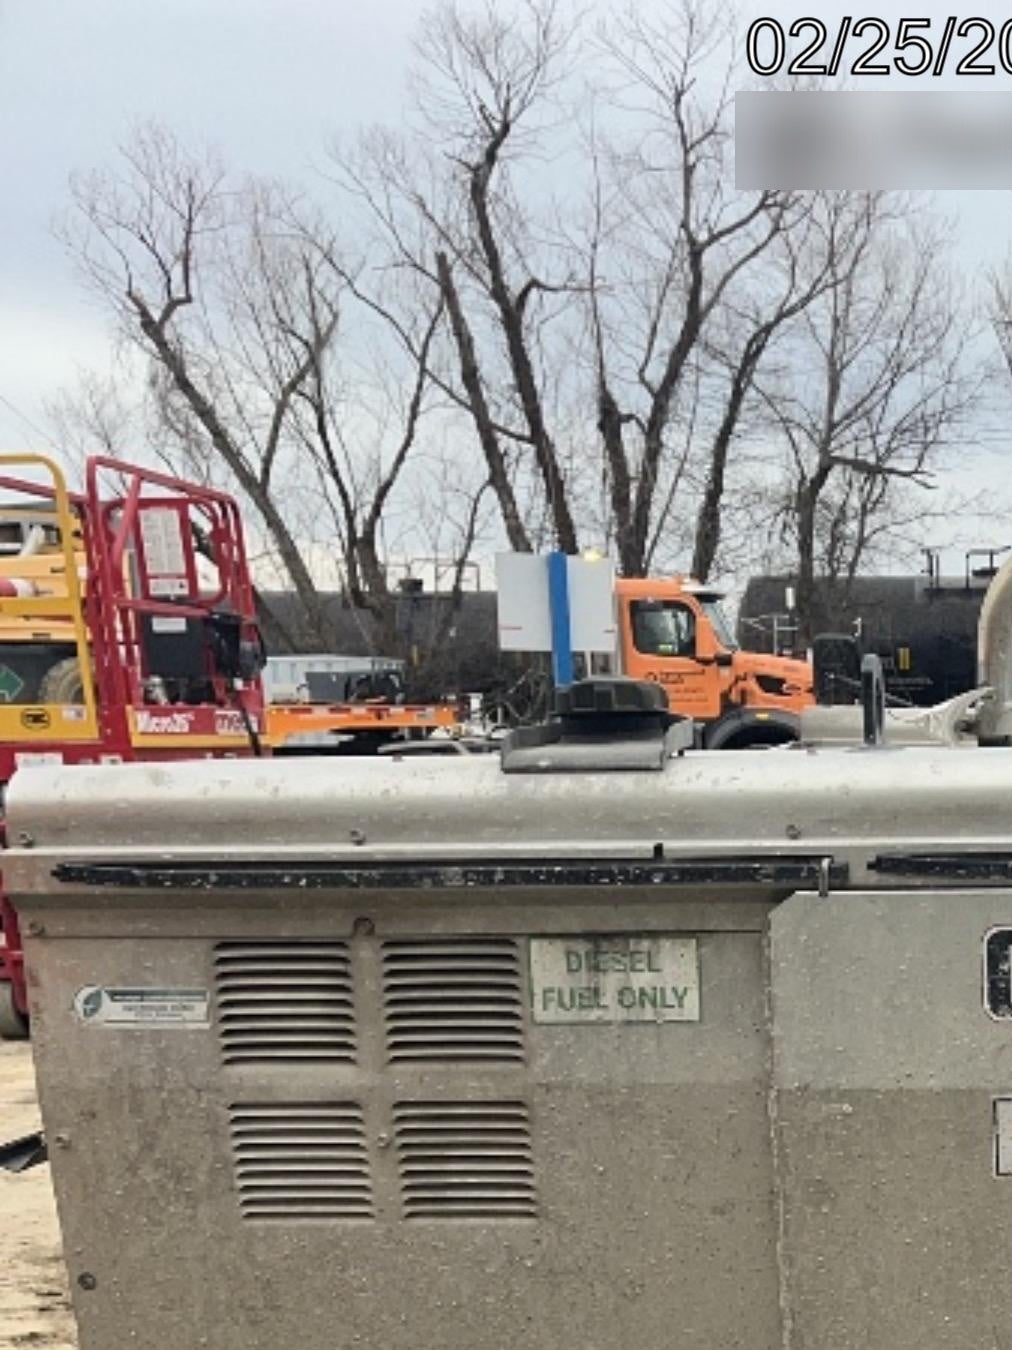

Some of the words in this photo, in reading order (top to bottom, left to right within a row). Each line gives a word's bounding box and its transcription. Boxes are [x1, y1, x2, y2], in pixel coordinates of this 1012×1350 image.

[566, 951, 663, 973] DIESEL
[542, 986, 609, 1011] FUEL
[617, 985, 688, 1009] ONLY
